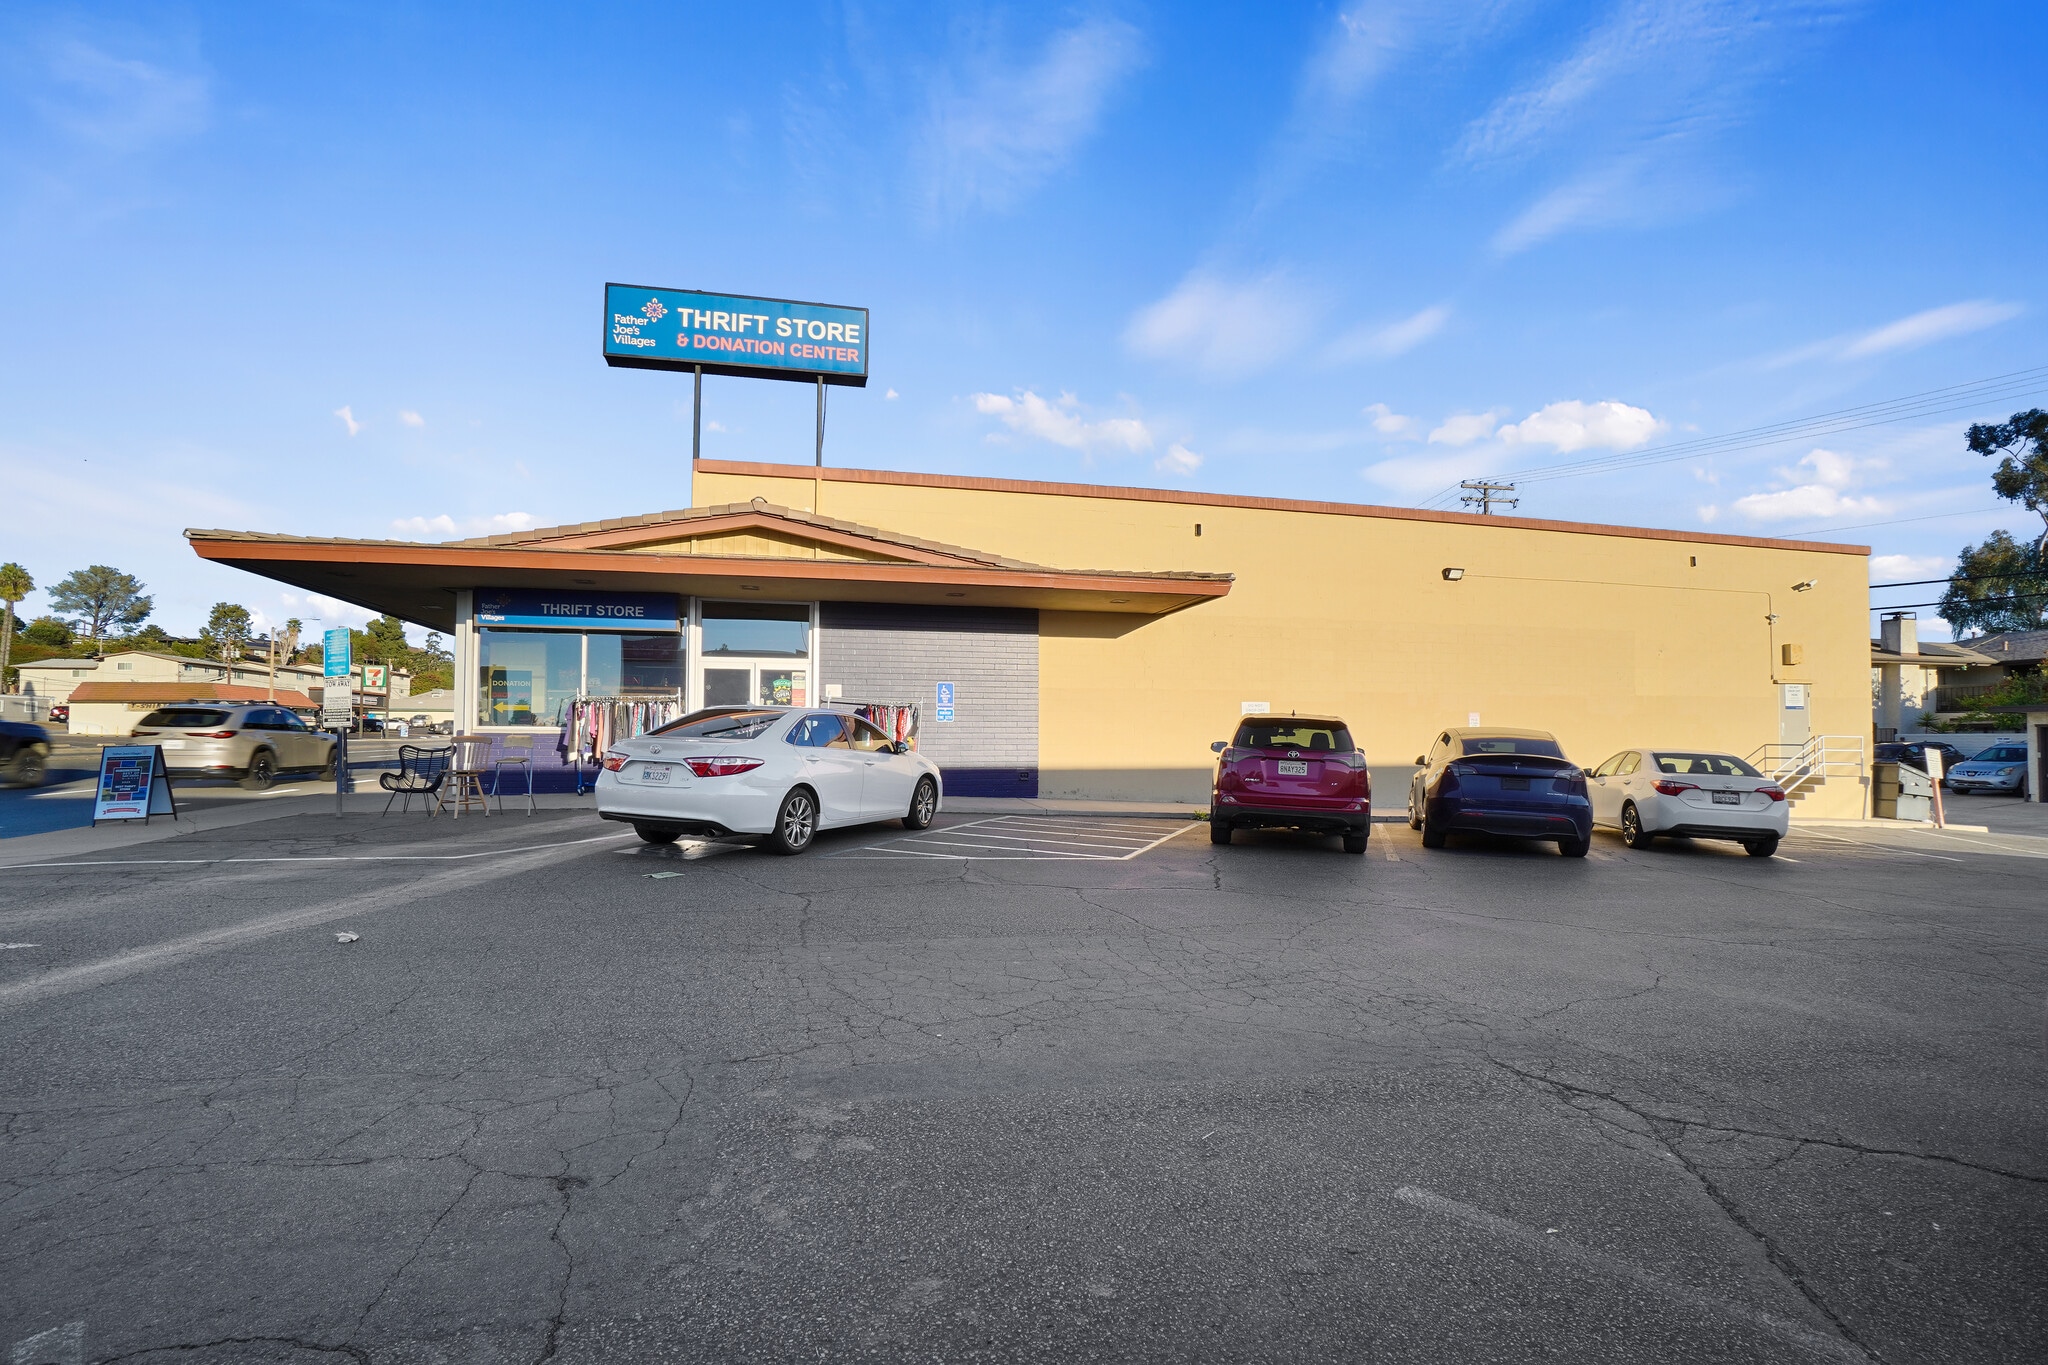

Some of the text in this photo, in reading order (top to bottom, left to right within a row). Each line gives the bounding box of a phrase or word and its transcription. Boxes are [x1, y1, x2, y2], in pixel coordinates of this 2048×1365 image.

[614, 314, 648, 326] Father
[677, 308, 860, 343] THRIFT STORE
[613, 325, 640, 335] Joe's
[613, 335, 656, 348] Villages
[676, 333, 859, 362] & DONATION CENTER
[541, 603, 645, 617] THRIFT STORE
[481, 614, 505, 622] Villages
